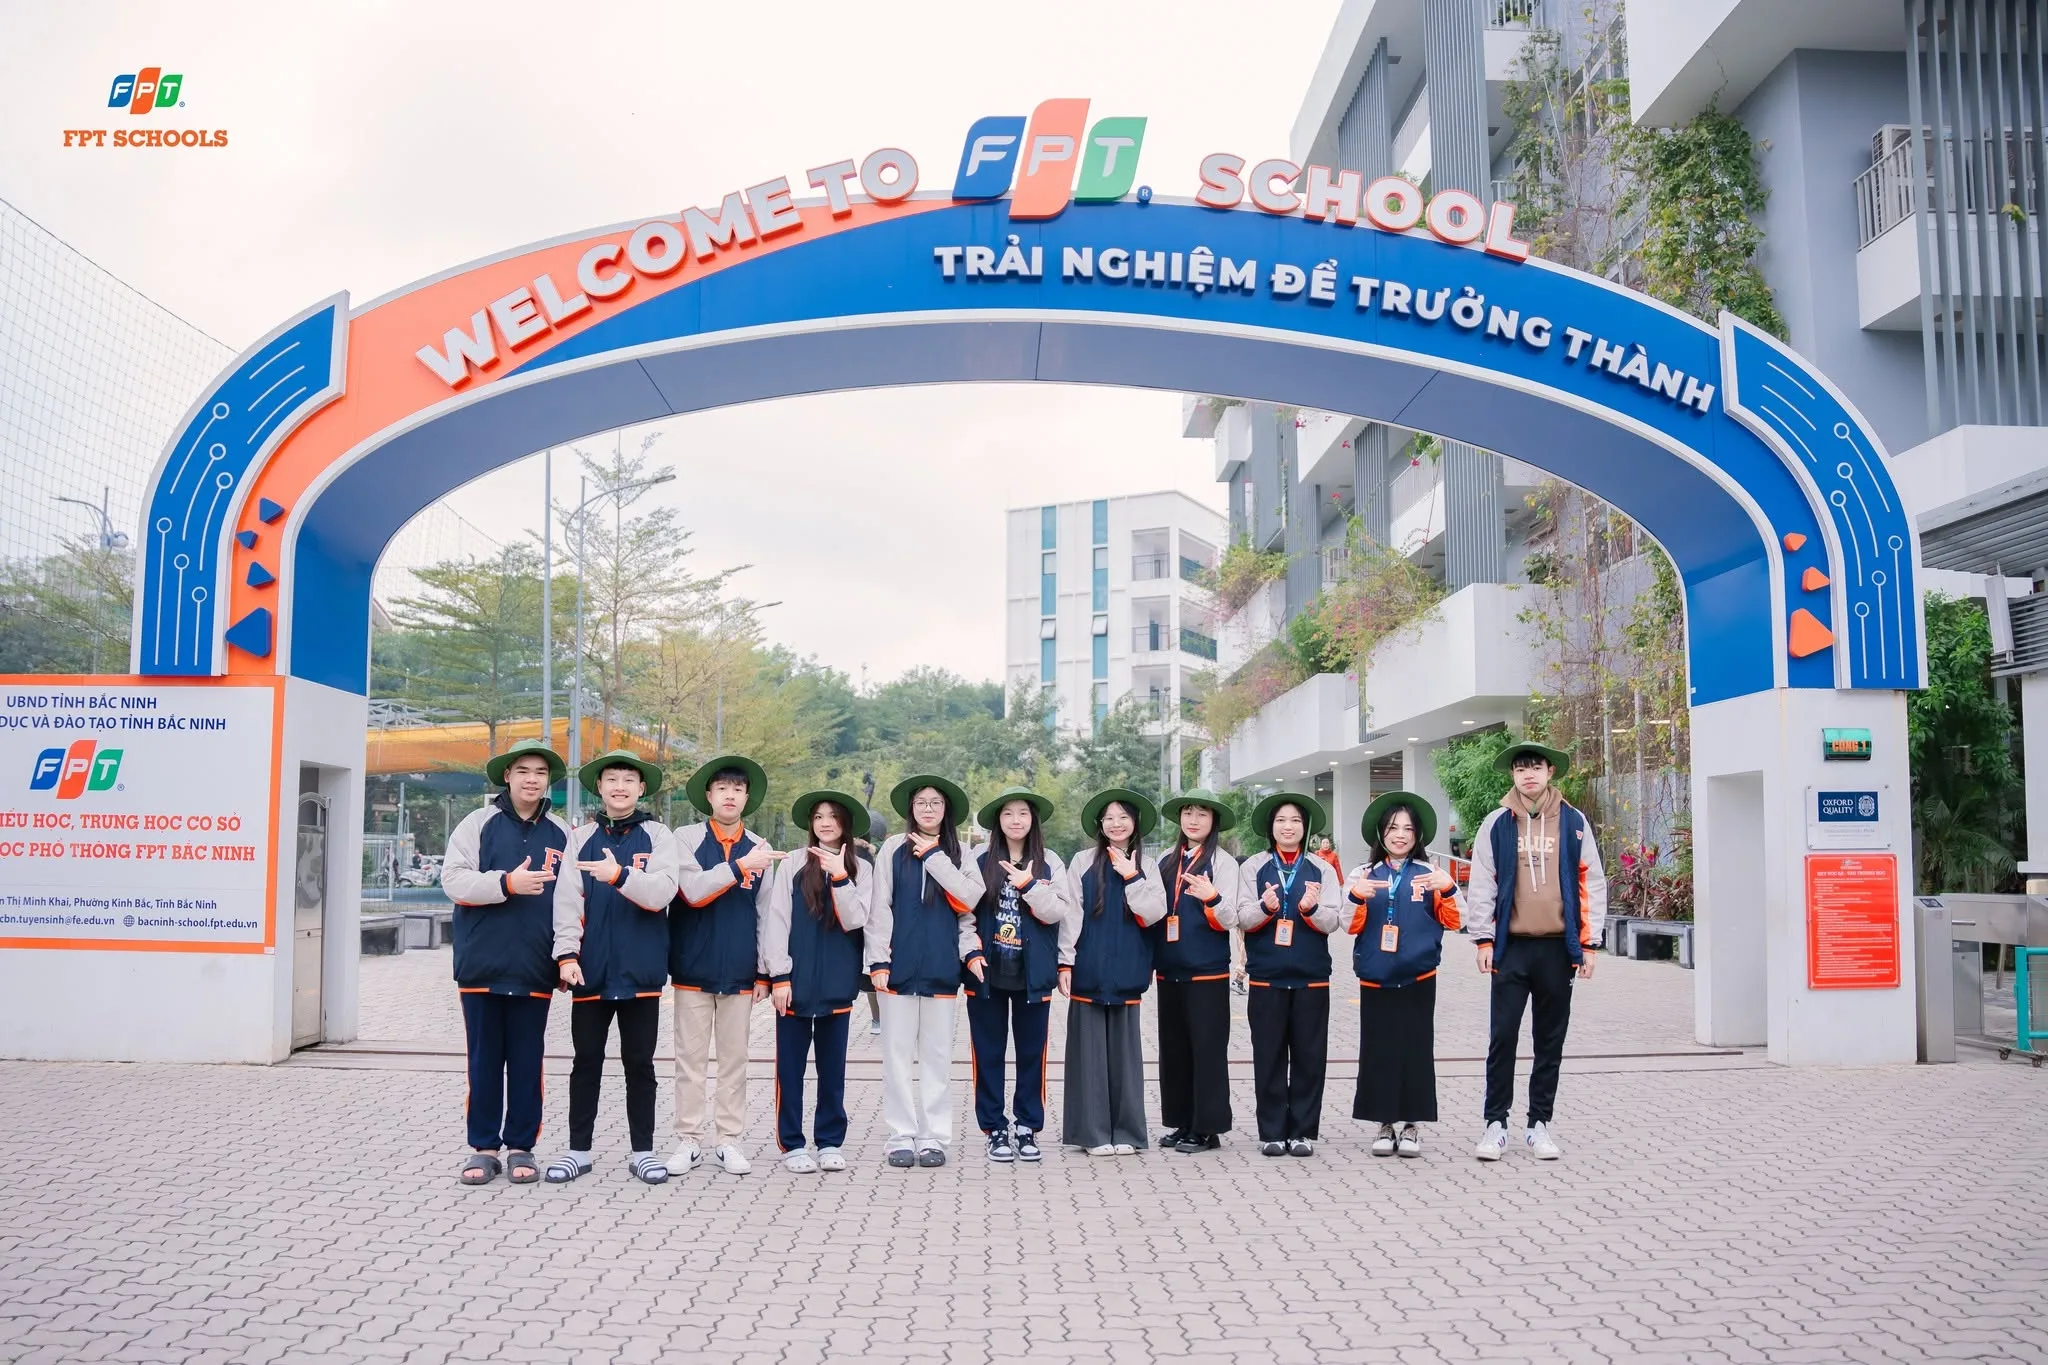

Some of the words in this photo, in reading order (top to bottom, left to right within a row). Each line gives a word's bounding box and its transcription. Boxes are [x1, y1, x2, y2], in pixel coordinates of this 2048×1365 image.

[1195, 152, 1530, 263] SCHOOL
[415, 175, 804, 391] WELCOME
[806, 147, 920, 220] TO
[933, 233, 1044, 281] TRẢI
[1061, 245, 1258, 294] NGHIỆM
[1270, 257, 1338, 307] ĐỂ
[1351, 275, 1553, 350] TRƯỞNG
[1562, 326, 1716, 414] THÀNH
[7, 695, 48, 708] UBND
[51, 692, 85, 709] TỈNH
[89, 692, 117, 709] BẮC
[120, 696, 157, 709] NINH
[0, 715, 28, 731] DỤC
[32, 713, 50, 729] VÀ
[53, 713, 86, 729] ĐÀO
[88, 716, 117, 732] TẠO
[120, 713, 154, 730] TỈNH
[157, 713, 186, 730] BẮC
[189, 718, 226, 730] NINH
[1861, 740, 1867, 752] 1
[1822, 799, 1854, 807] OXFORD
[1822, 806, 1854, 815] QUALITY
[32, 813, 75, 831] HỌC,
[80, 814, 140, 830] TRUNG
[143, 815, 183, 833] HỌC
[186, 815, 213, 831] CƠ
[217, 811, 242, 832] SỞ
[28, 838, 65, 858] PHỔ
[69, 841, 131, 859] THÔNG
[135, 844, 168, 860] FPT
[171, 840, 207, 860] BẮC
[211, 845, 256, 861] NINH
[22, 896, 47, 906] Minh
[48, 897, 72, 908] Khai,
[74, 897, 110, 909] Phường
[111, 898, 133, 908] Kinh
[195, 899, 217, 910] Ninh
[137, 916, 258, 930] bacninh-school.fpt.edu.vn
